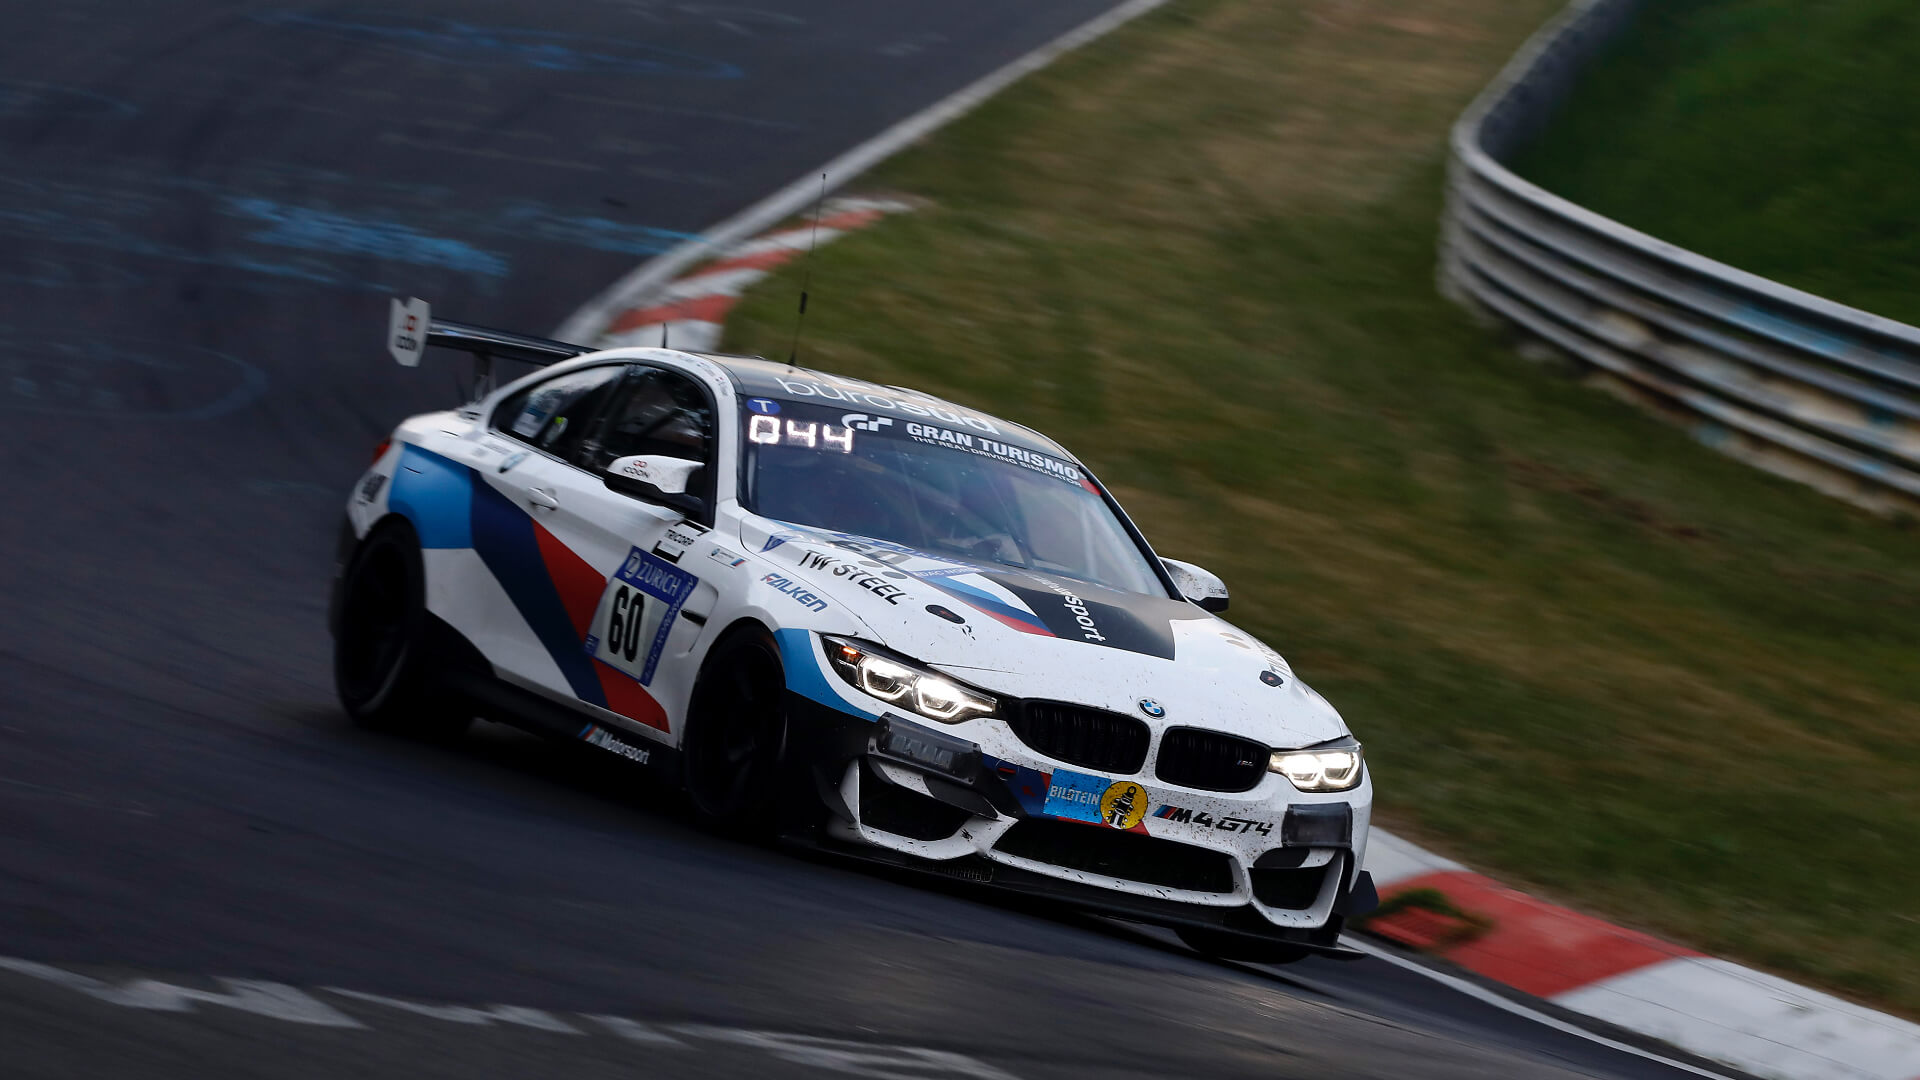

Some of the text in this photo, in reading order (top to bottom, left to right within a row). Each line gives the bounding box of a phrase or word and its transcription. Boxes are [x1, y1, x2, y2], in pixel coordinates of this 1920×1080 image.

[753, 399, 772, 413] T
[906, 422, 1080, 480] GRAN TURISMO
[911, 435, 1083, 488] THE REAL DRIVING SIMULATOR
[760, 573, 828, 613] FALKEN
[798, 549, 907, 606] TW STEEL
[608, 585, 645, 663] 60
[1049, 785, 1100, 806] BILSTEIN
